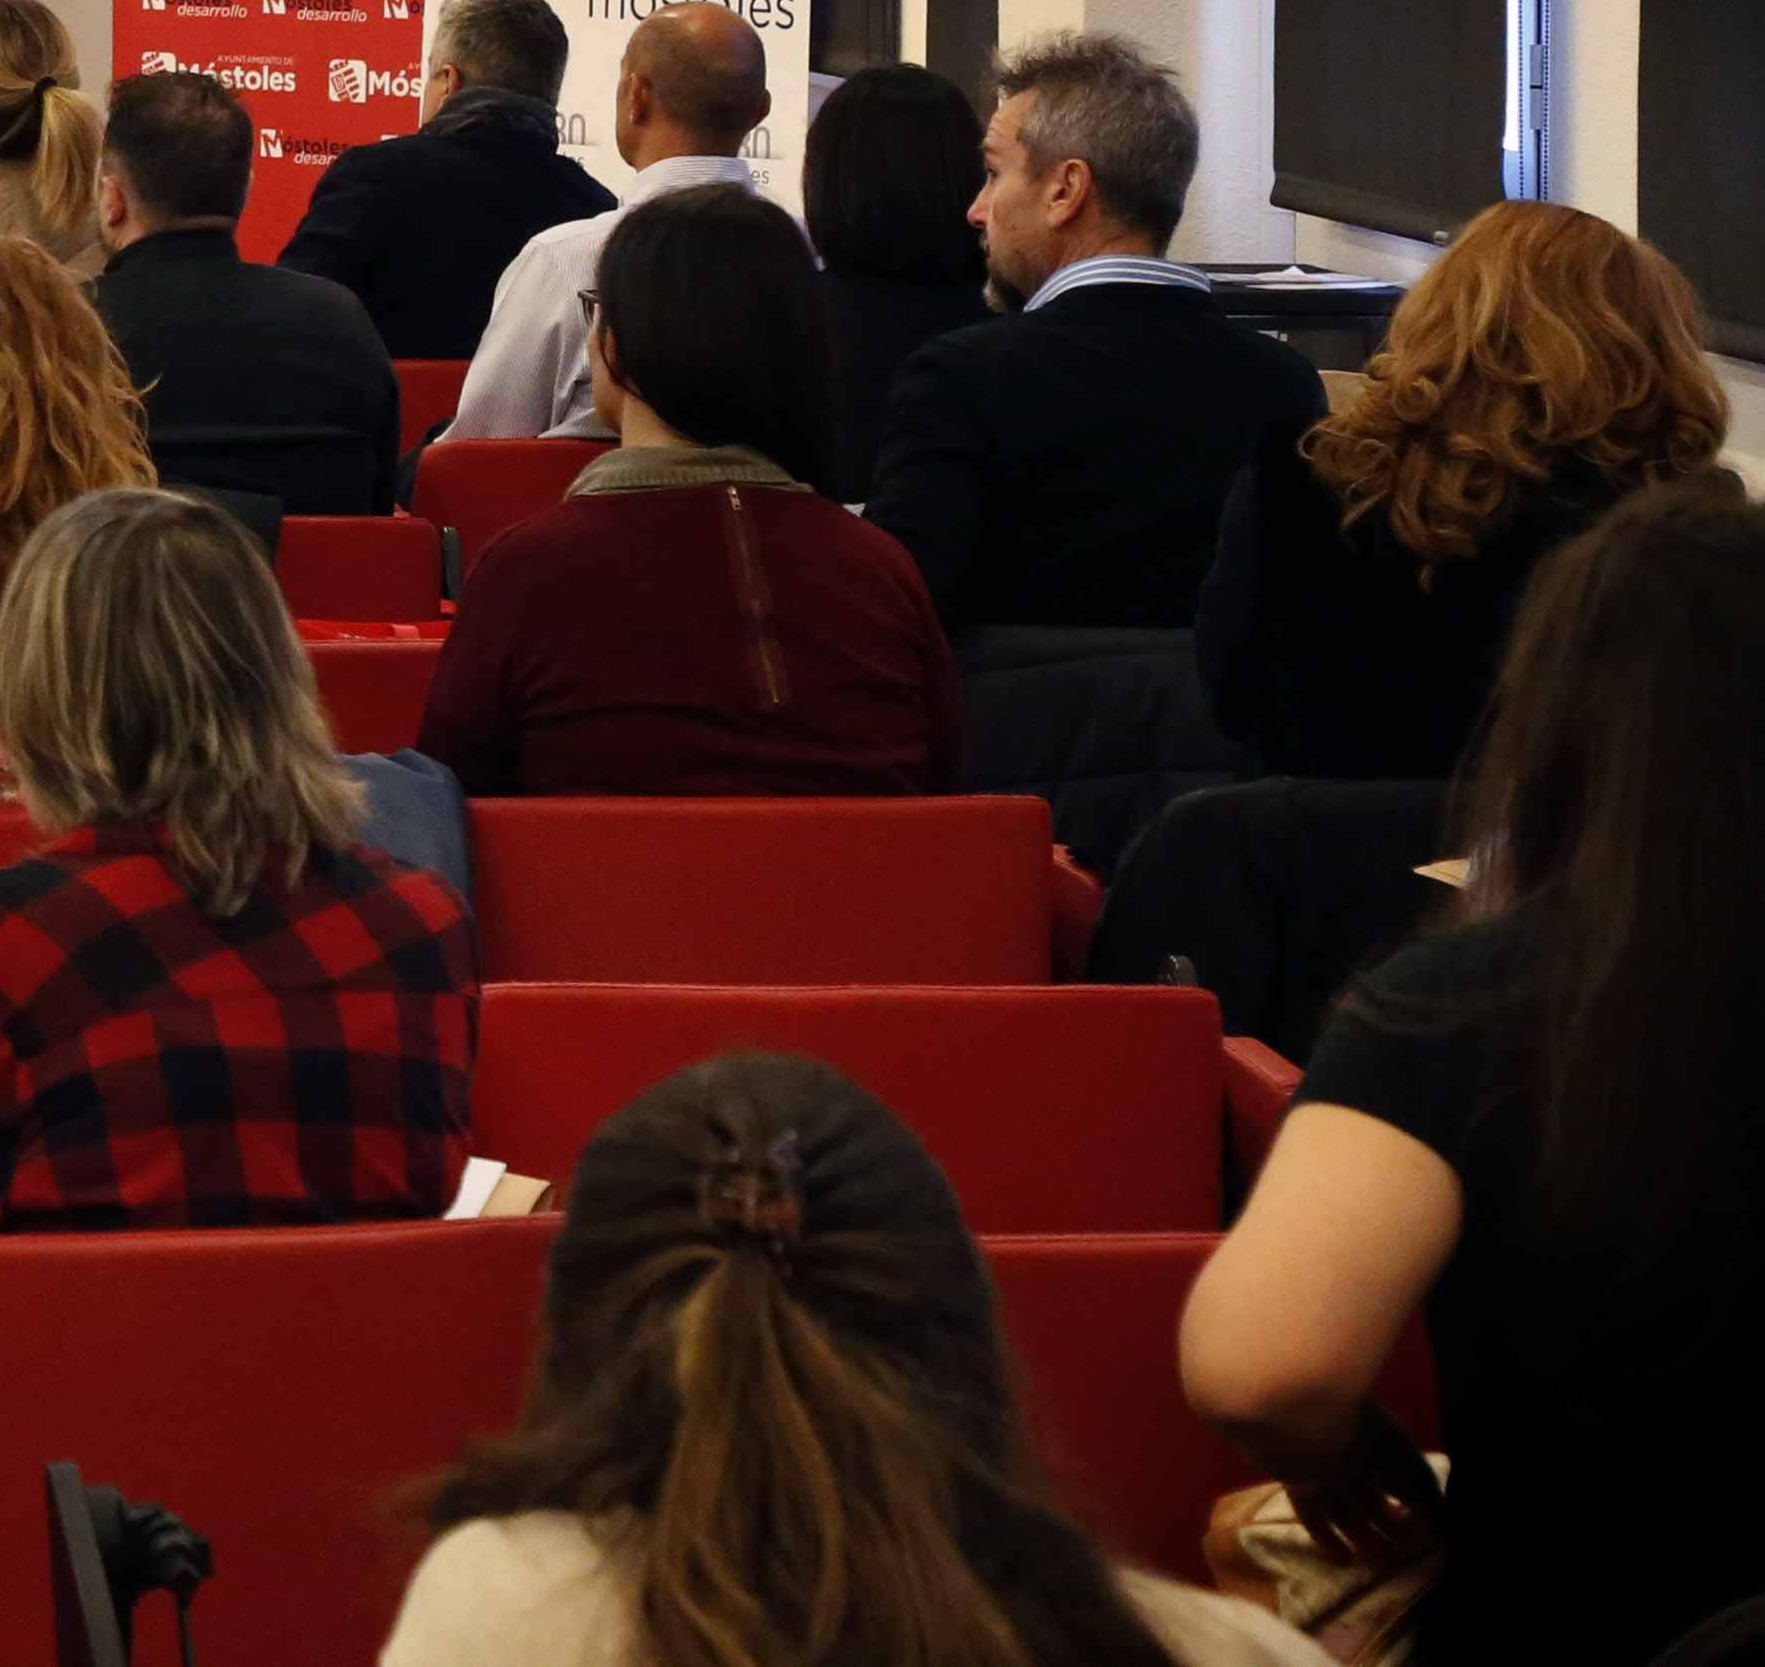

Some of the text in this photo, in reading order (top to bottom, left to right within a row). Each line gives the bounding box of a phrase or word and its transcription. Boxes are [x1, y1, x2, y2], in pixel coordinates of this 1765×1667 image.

[178, 4, 247, 18] desarrollo
[297, 7, 367, 22] desarrollo
[217, 55, 294, 65] AYUNTAMIENTO DE
